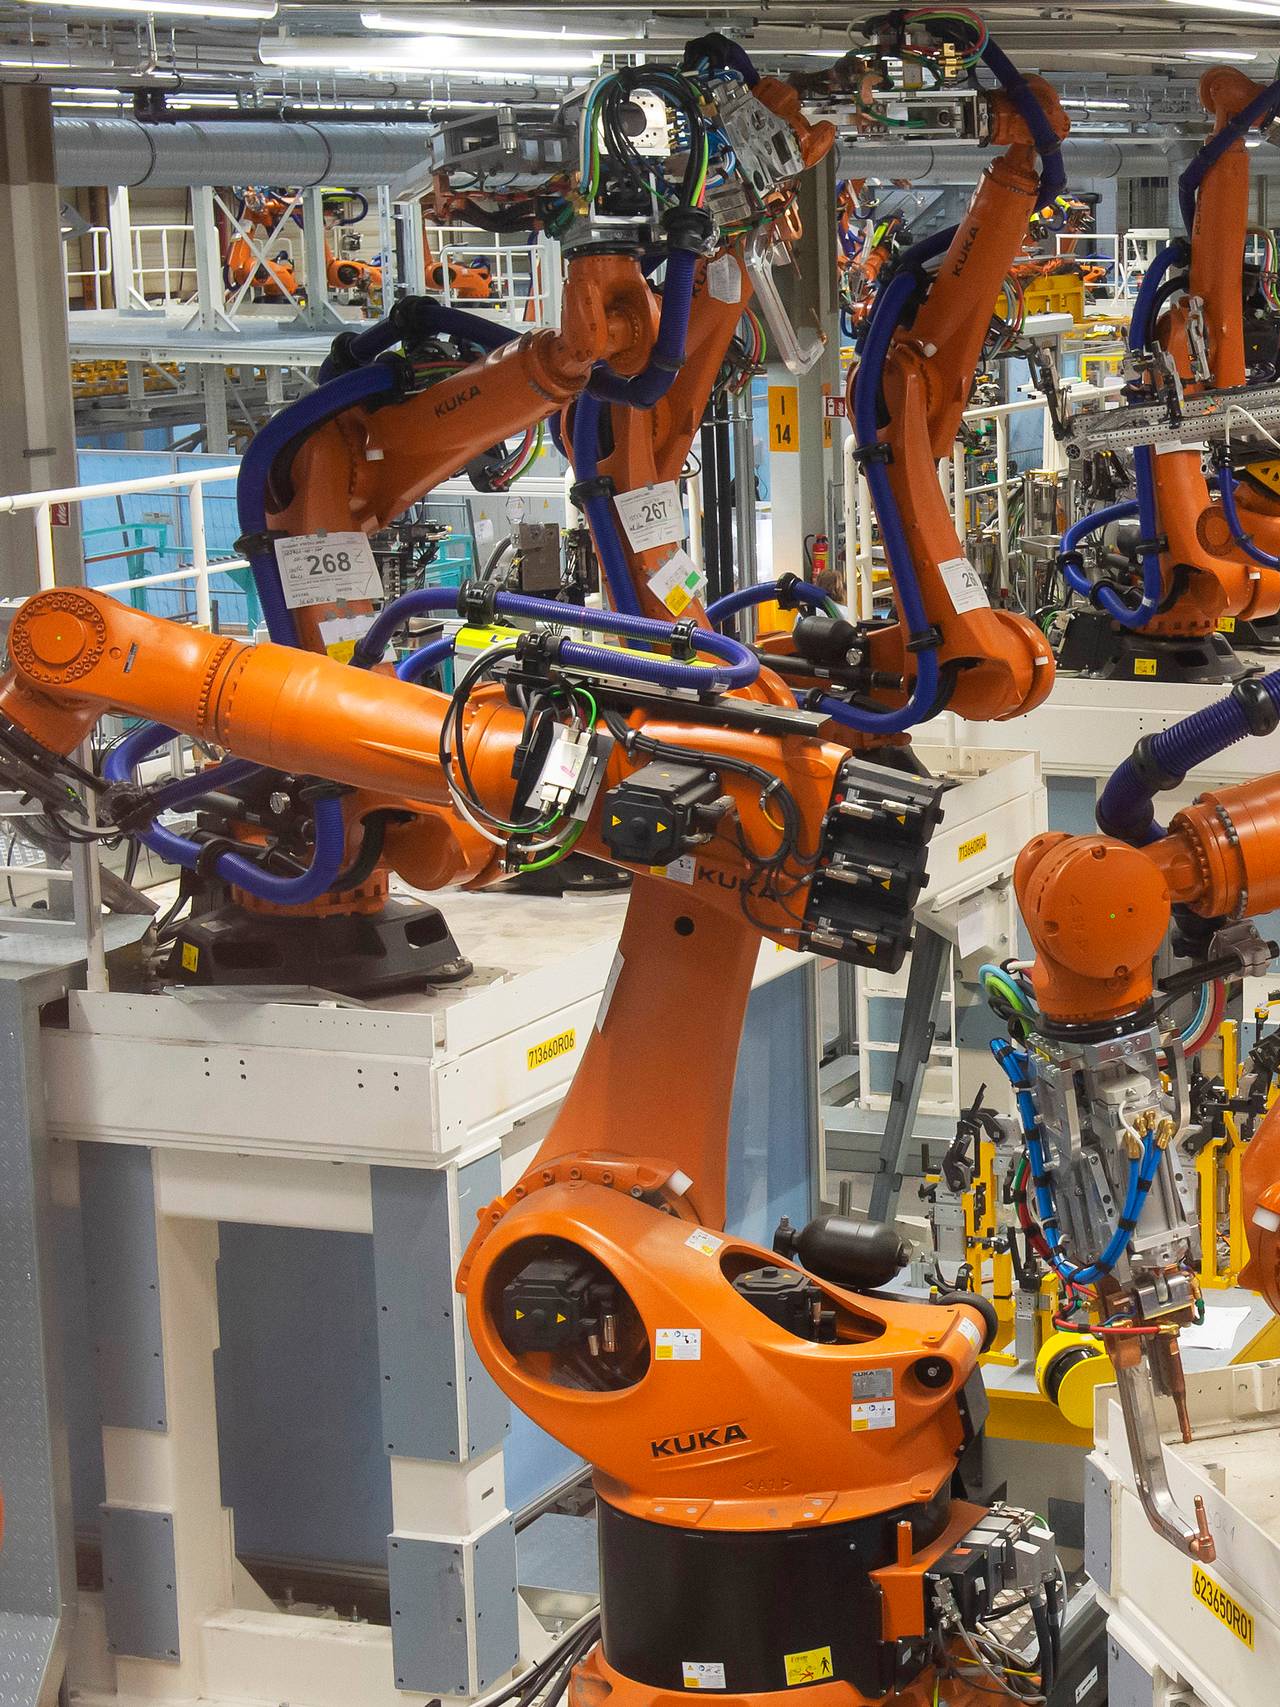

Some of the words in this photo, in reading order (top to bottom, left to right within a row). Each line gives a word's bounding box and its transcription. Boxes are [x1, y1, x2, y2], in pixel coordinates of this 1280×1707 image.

[951, 227, 979, 277] KUKA
[434, 384, 481, 417] KUKA
[776, 423, 791, 444] 14
[642, 501, 668, 523] 267
[306, 551, 351, 576] 268
[529, 1032, 575, 1068] 713660R06
[651, 1424, 748, 1457] KUKA
[1194, 1570, 1252, 1646] 623650R01
